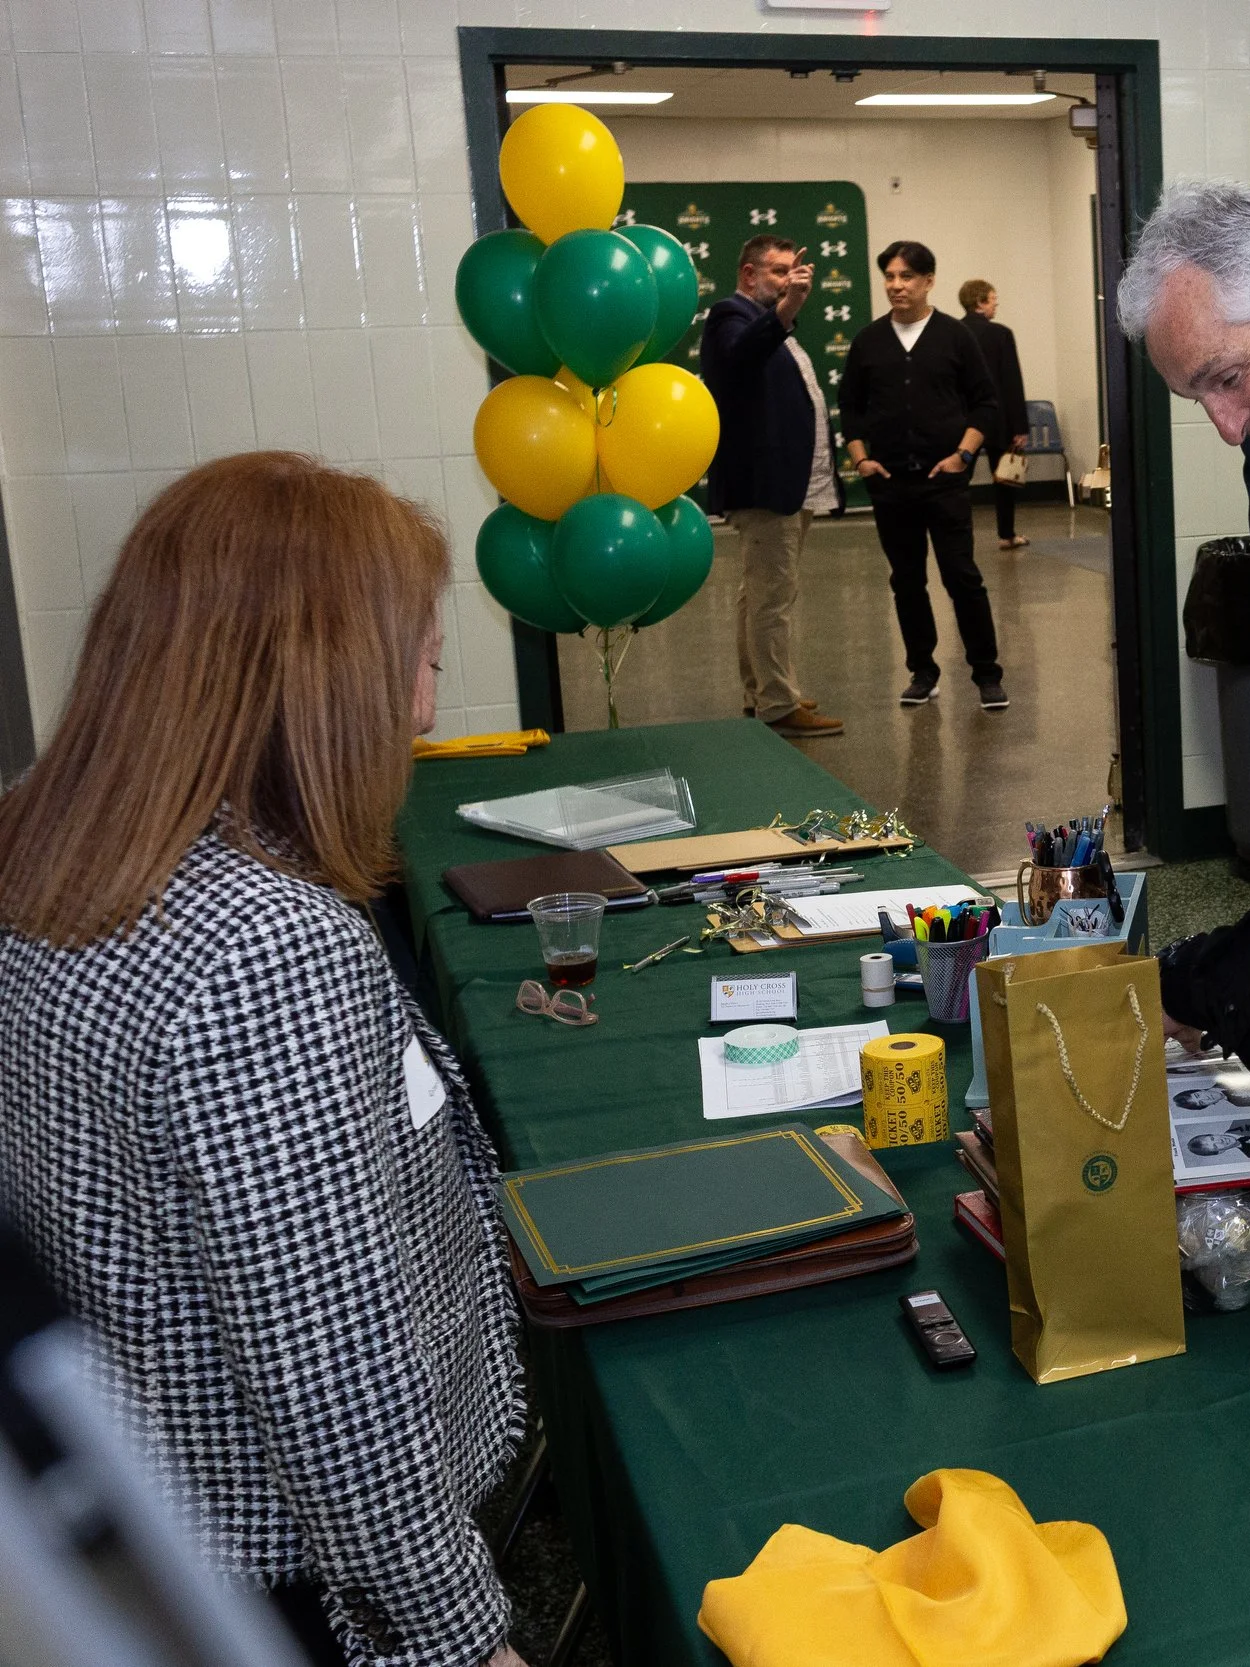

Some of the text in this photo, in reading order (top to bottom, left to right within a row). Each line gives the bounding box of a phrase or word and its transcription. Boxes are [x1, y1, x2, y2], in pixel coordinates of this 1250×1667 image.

[895, 1062, 907, 1104] 50/50
[887, 1111, 898, 1146] ICKET
[897, 1110, 909, 1146] 0/50
